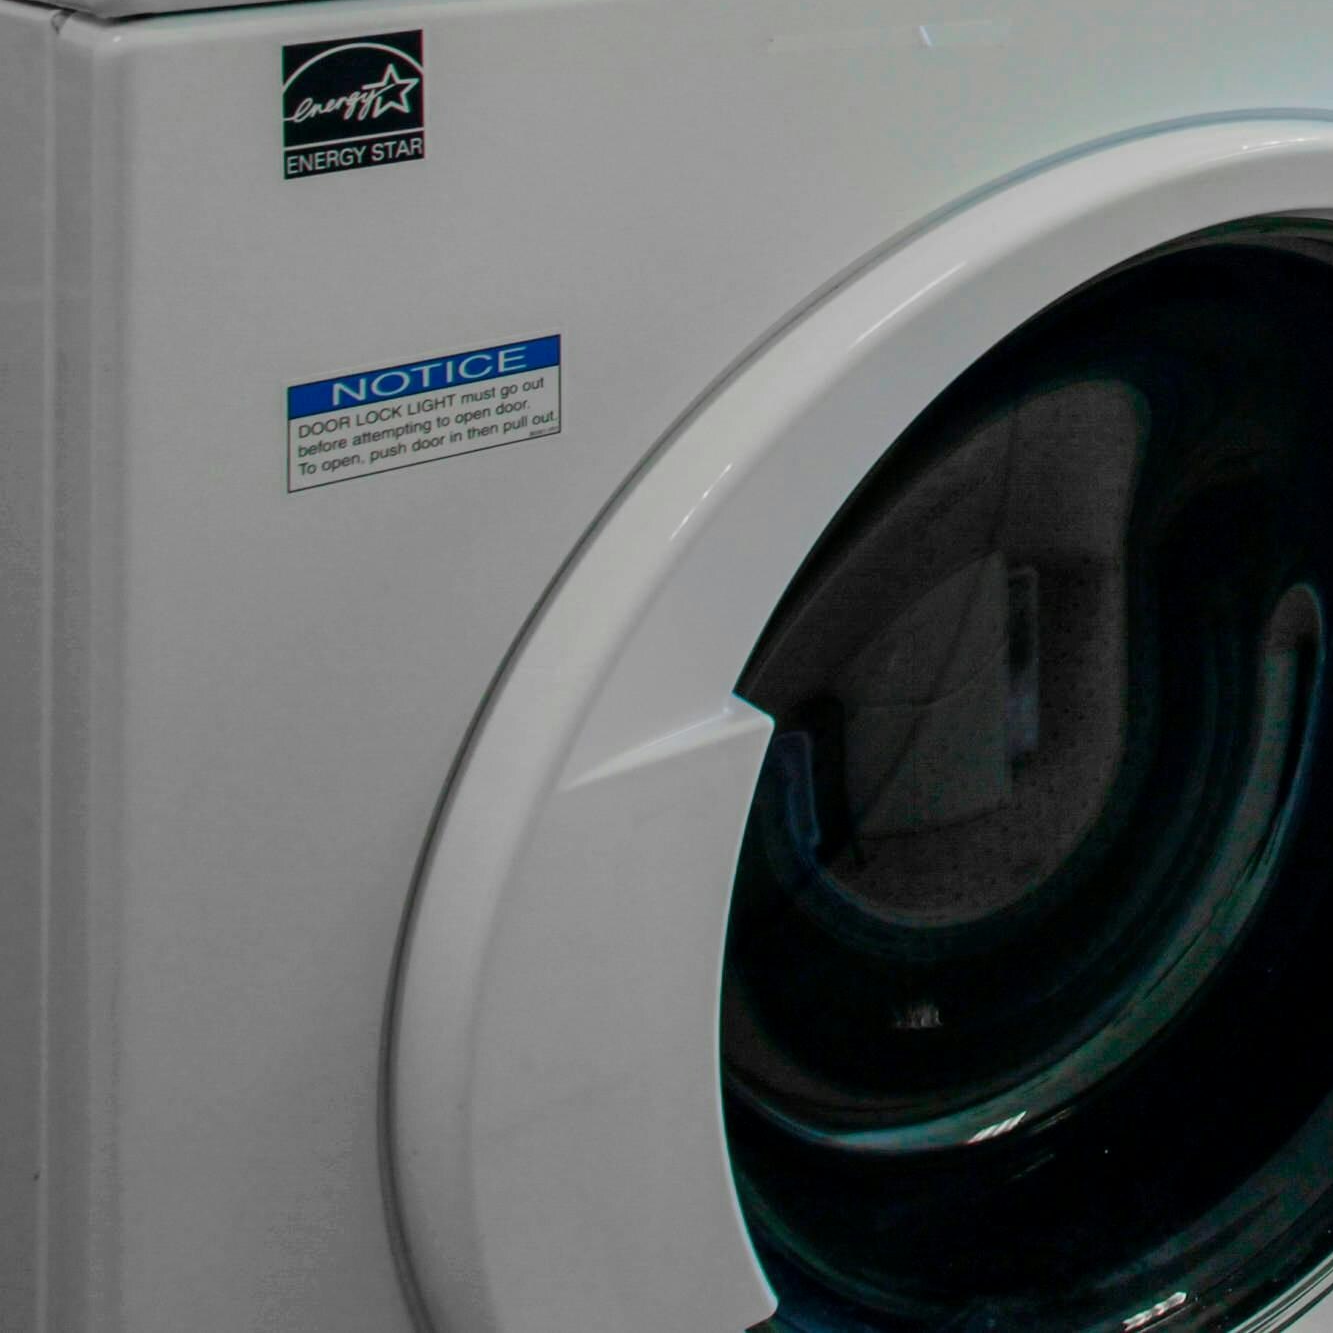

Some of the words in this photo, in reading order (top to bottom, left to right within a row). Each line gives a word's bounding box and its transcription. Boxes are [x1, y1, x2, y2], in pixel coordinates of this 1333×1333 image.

[287, 146, 366, 175] ENERGY
[371, 137, 424, 162] STAR
[333, 345, 529, 406] NOTICE
[298, 416, 351, 439] DOOR
[356, 404, 403, 428] LOCK
[407, 393, 456, 416] LIGHT
[461, 386, 496, 405] must
[500, 384, 518, 399] go
[522, 377, 544, 392] out
[298, 437, 348, 458] before
[352, 420, 432, 447] attempting
[436, 415, 450, 429] to
[455, 407, 491, 426] open
[495, 399, 530, 416] door.
[298, 461, 317, 476] To
[369, 442, 407, 465] push
[411, 435, 445, 453] door
[449, 430, 462, 444] in
[467, 423, 499, 440] then
[503, 415, 528, 435] pull
